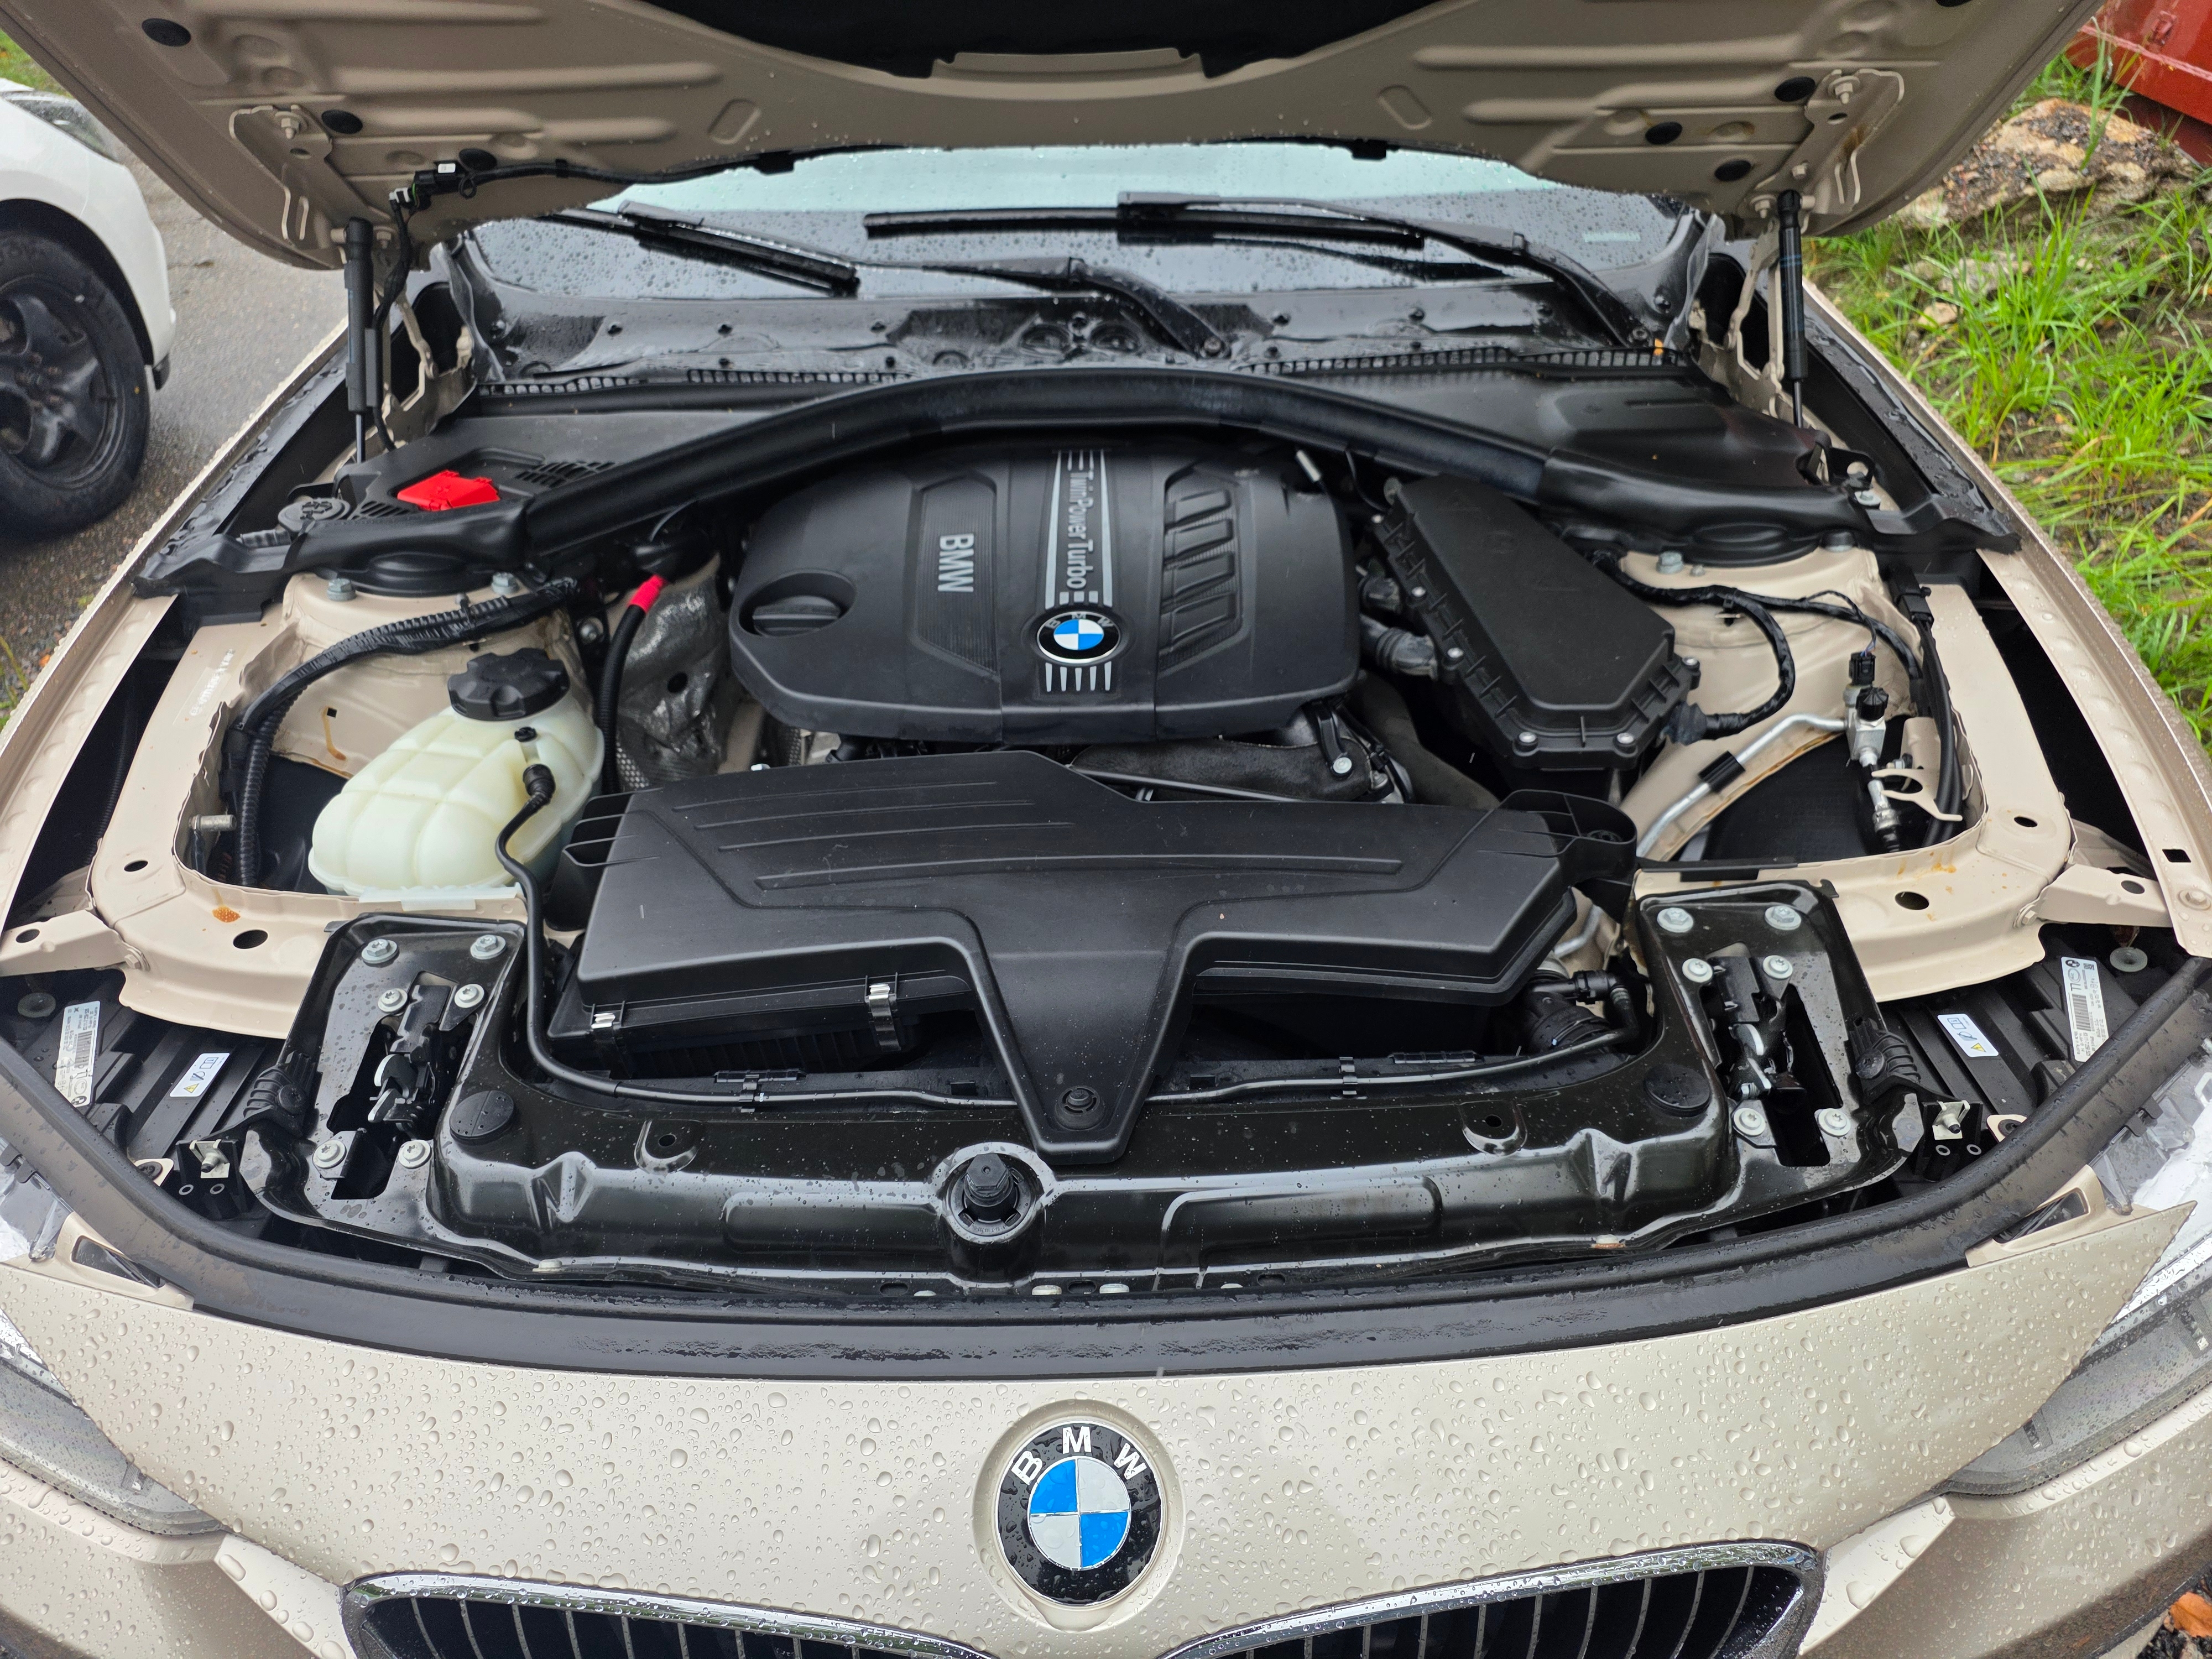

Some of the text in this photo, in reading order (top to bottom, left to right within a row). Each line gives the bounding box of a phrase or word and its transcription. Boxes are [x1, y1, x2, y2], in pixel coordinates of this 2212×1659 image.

[1066, 471, 1094, 589] TwinPower Turbo
[937, 533, 974, 592] BMW
[1044, 612, 1115, 629] BMW
[1011, 1426, 1147, 1485] BMW
